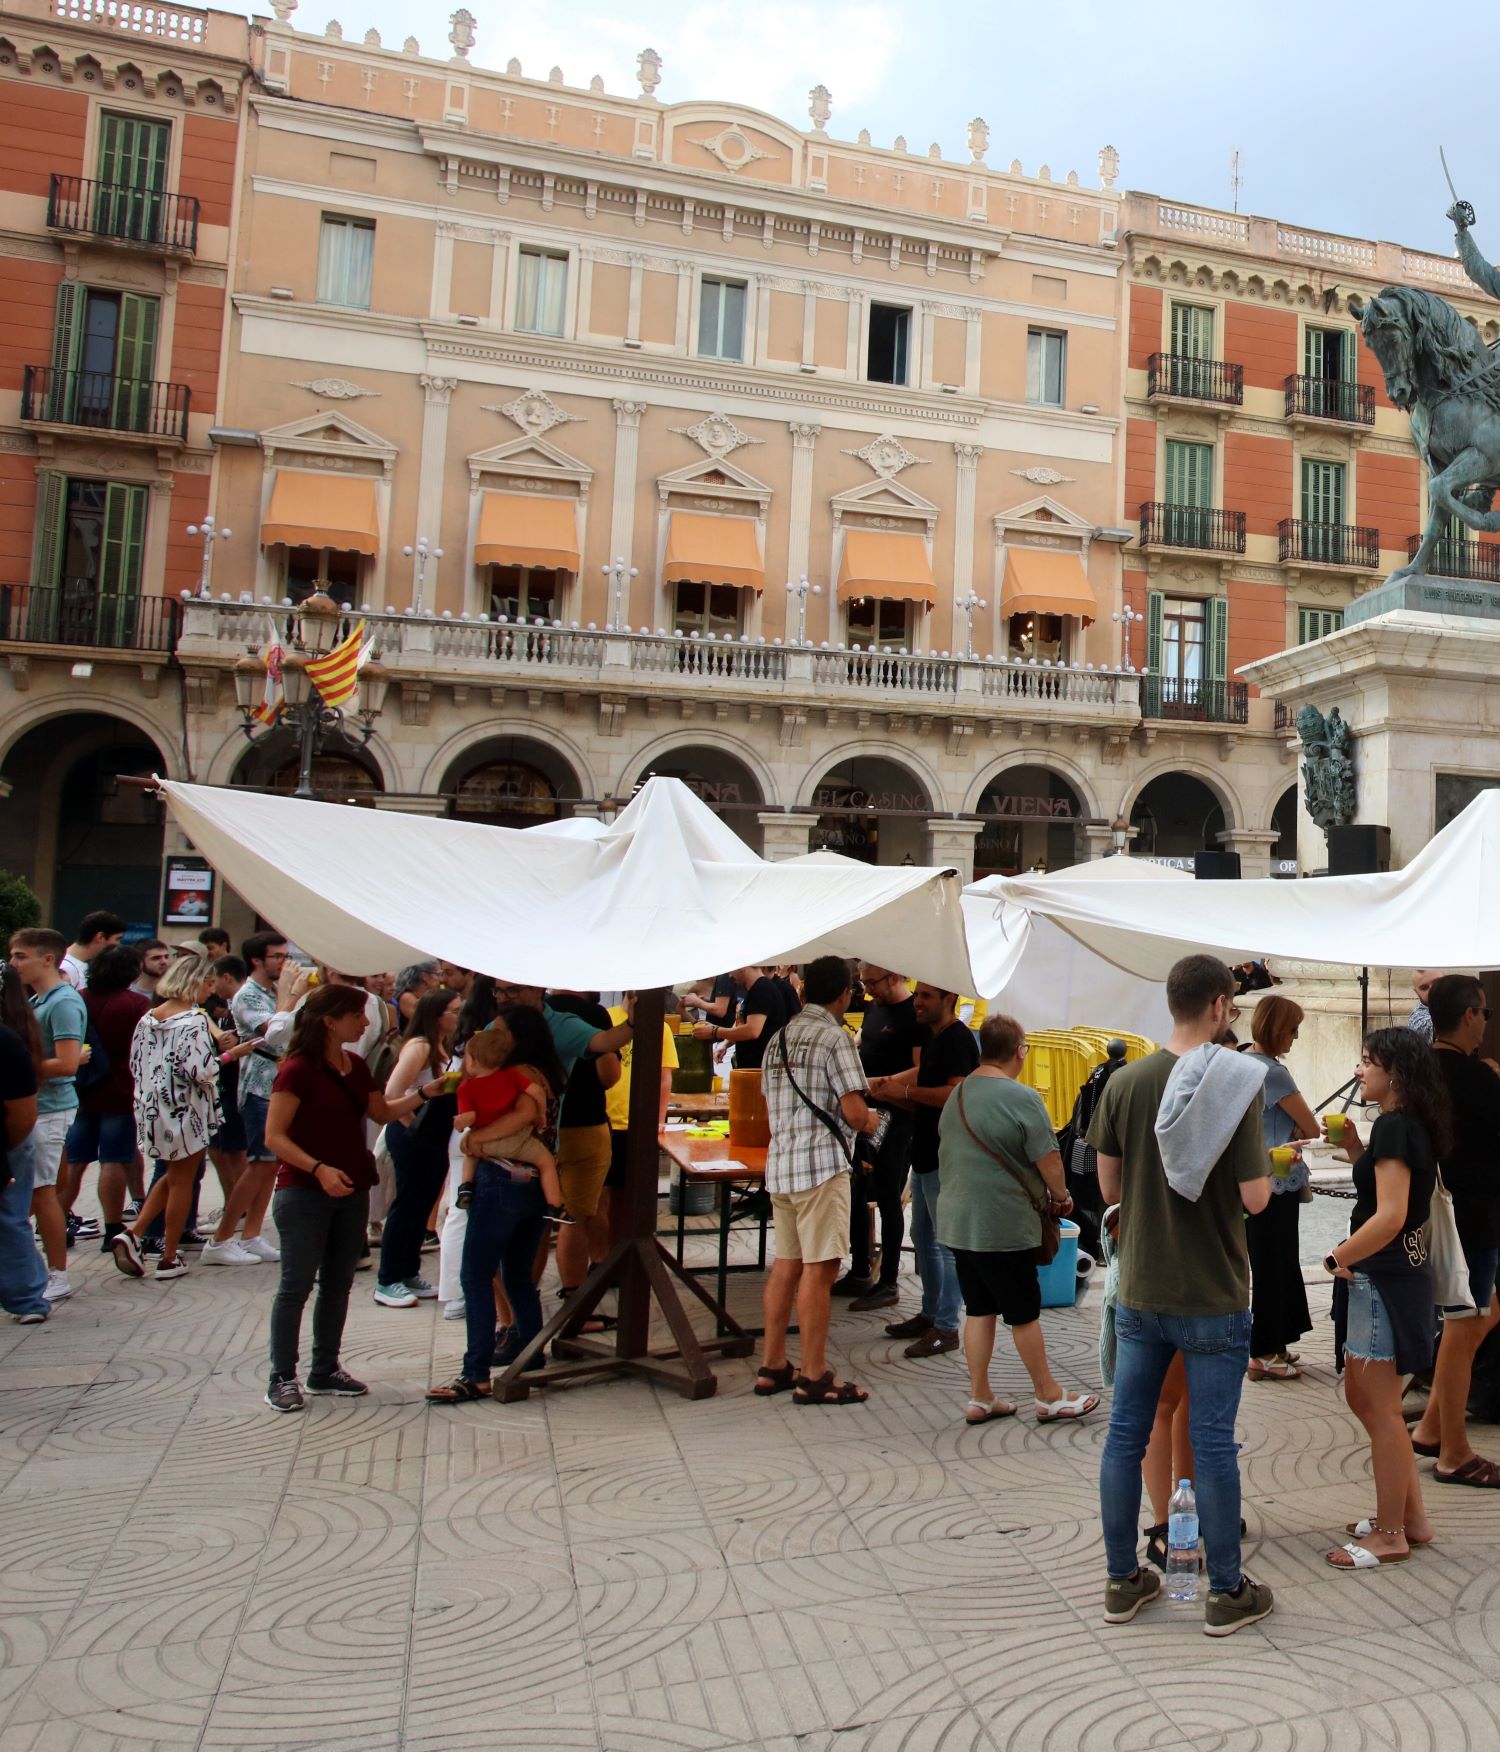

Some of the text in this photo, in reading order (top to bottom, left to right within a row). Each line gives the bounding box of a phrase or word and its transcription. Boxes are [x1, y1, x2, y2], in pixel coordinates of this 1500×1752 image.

[818, 790, 928, 811] EL CASINO
[992, 795, 1073, 817] VIENA
